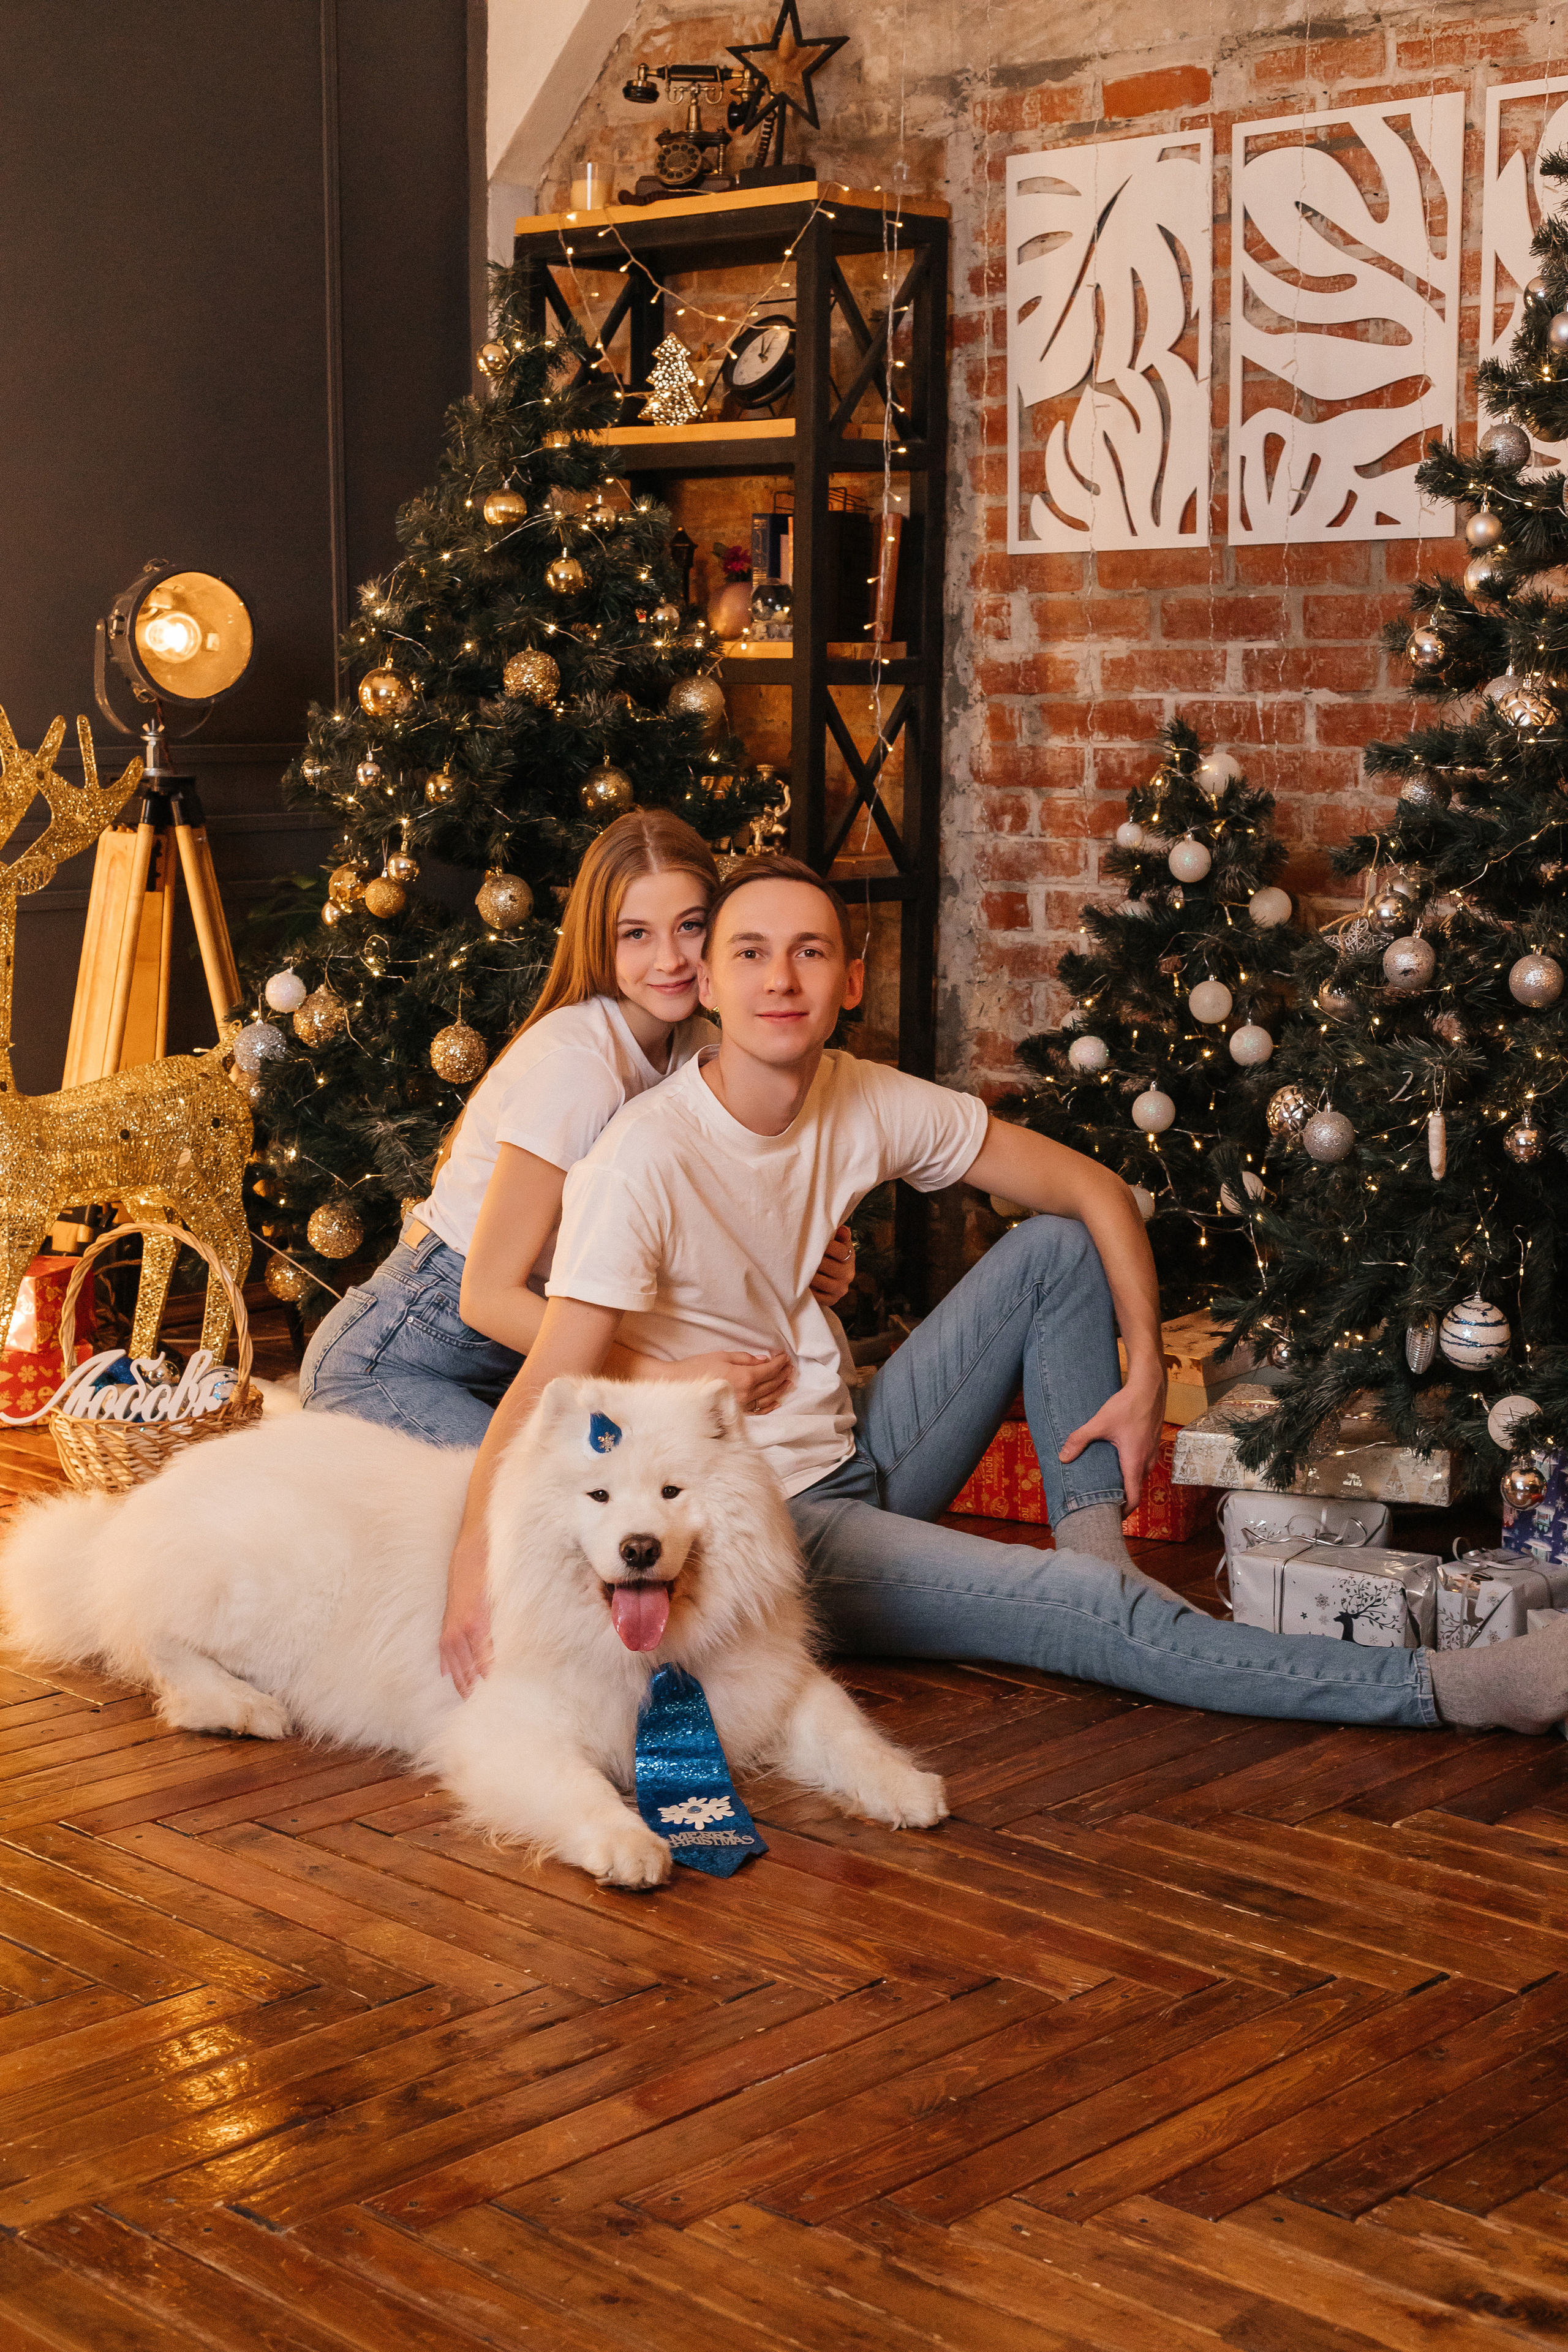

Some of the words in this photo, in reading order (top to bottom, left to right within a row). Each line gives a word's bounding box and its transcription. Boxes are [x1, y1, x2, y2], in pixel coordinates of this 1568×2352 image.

[0, 1349, 222, 1425] Любовь
[668, 1830, 736, 1842] MERRY
[669, 1835, 755, 1849] HRISTMAS
